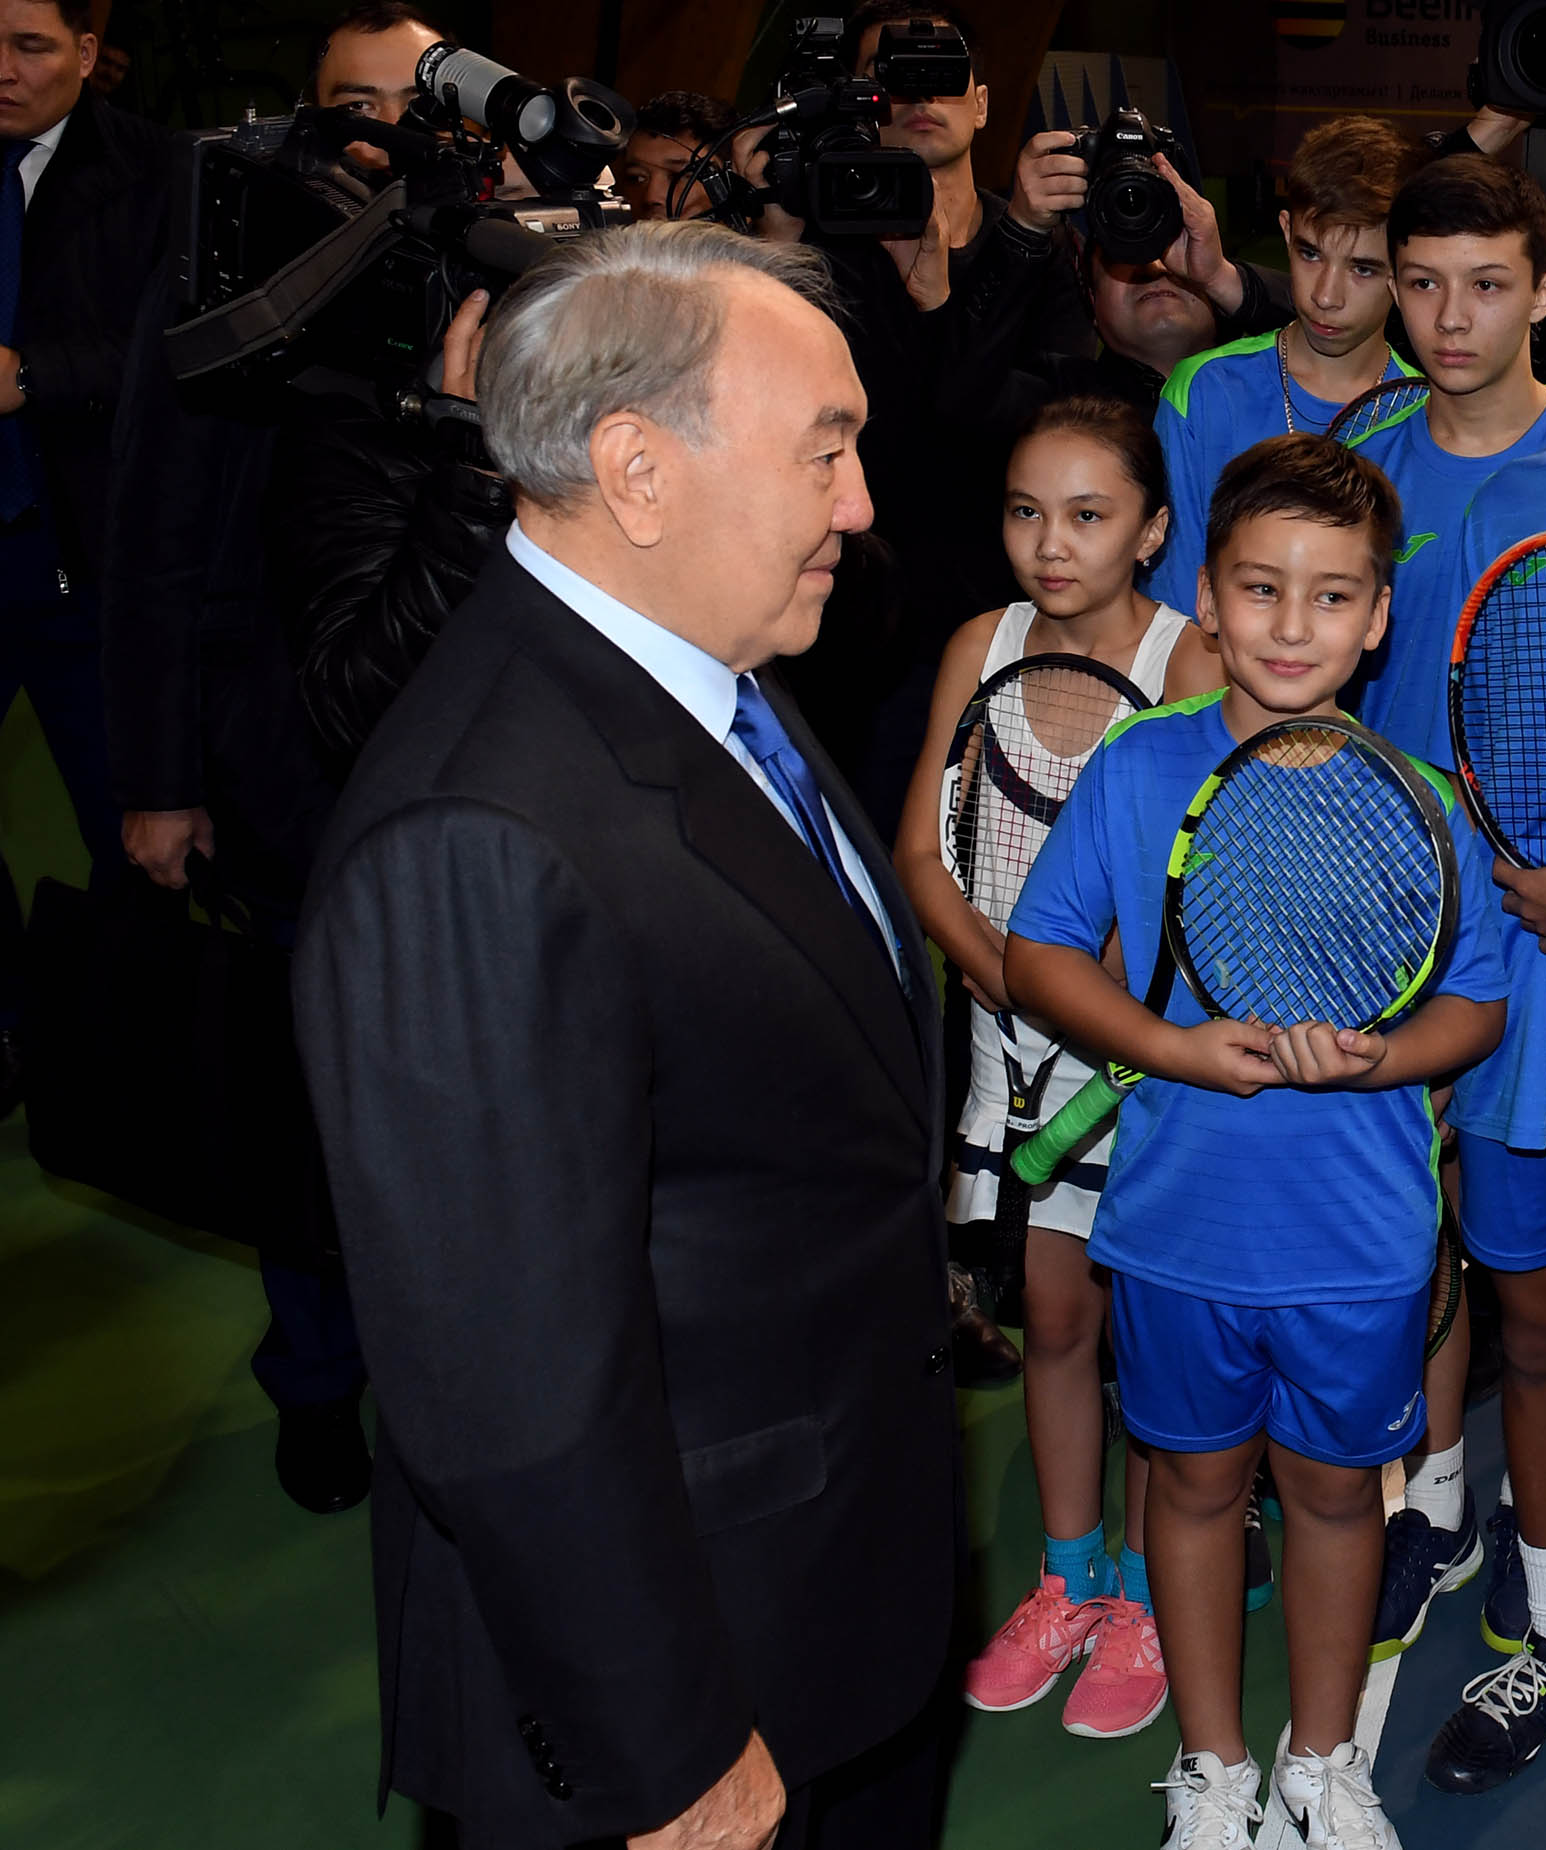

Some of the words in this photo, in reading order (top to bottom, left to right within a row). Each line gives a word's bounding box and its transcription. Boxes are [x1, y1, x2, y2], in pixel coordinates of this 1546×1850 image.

[1366, 27, 1451, 47] Business
[1115, 132, 1144, 141] Canon
[556, 223, 581, 232] SONY
